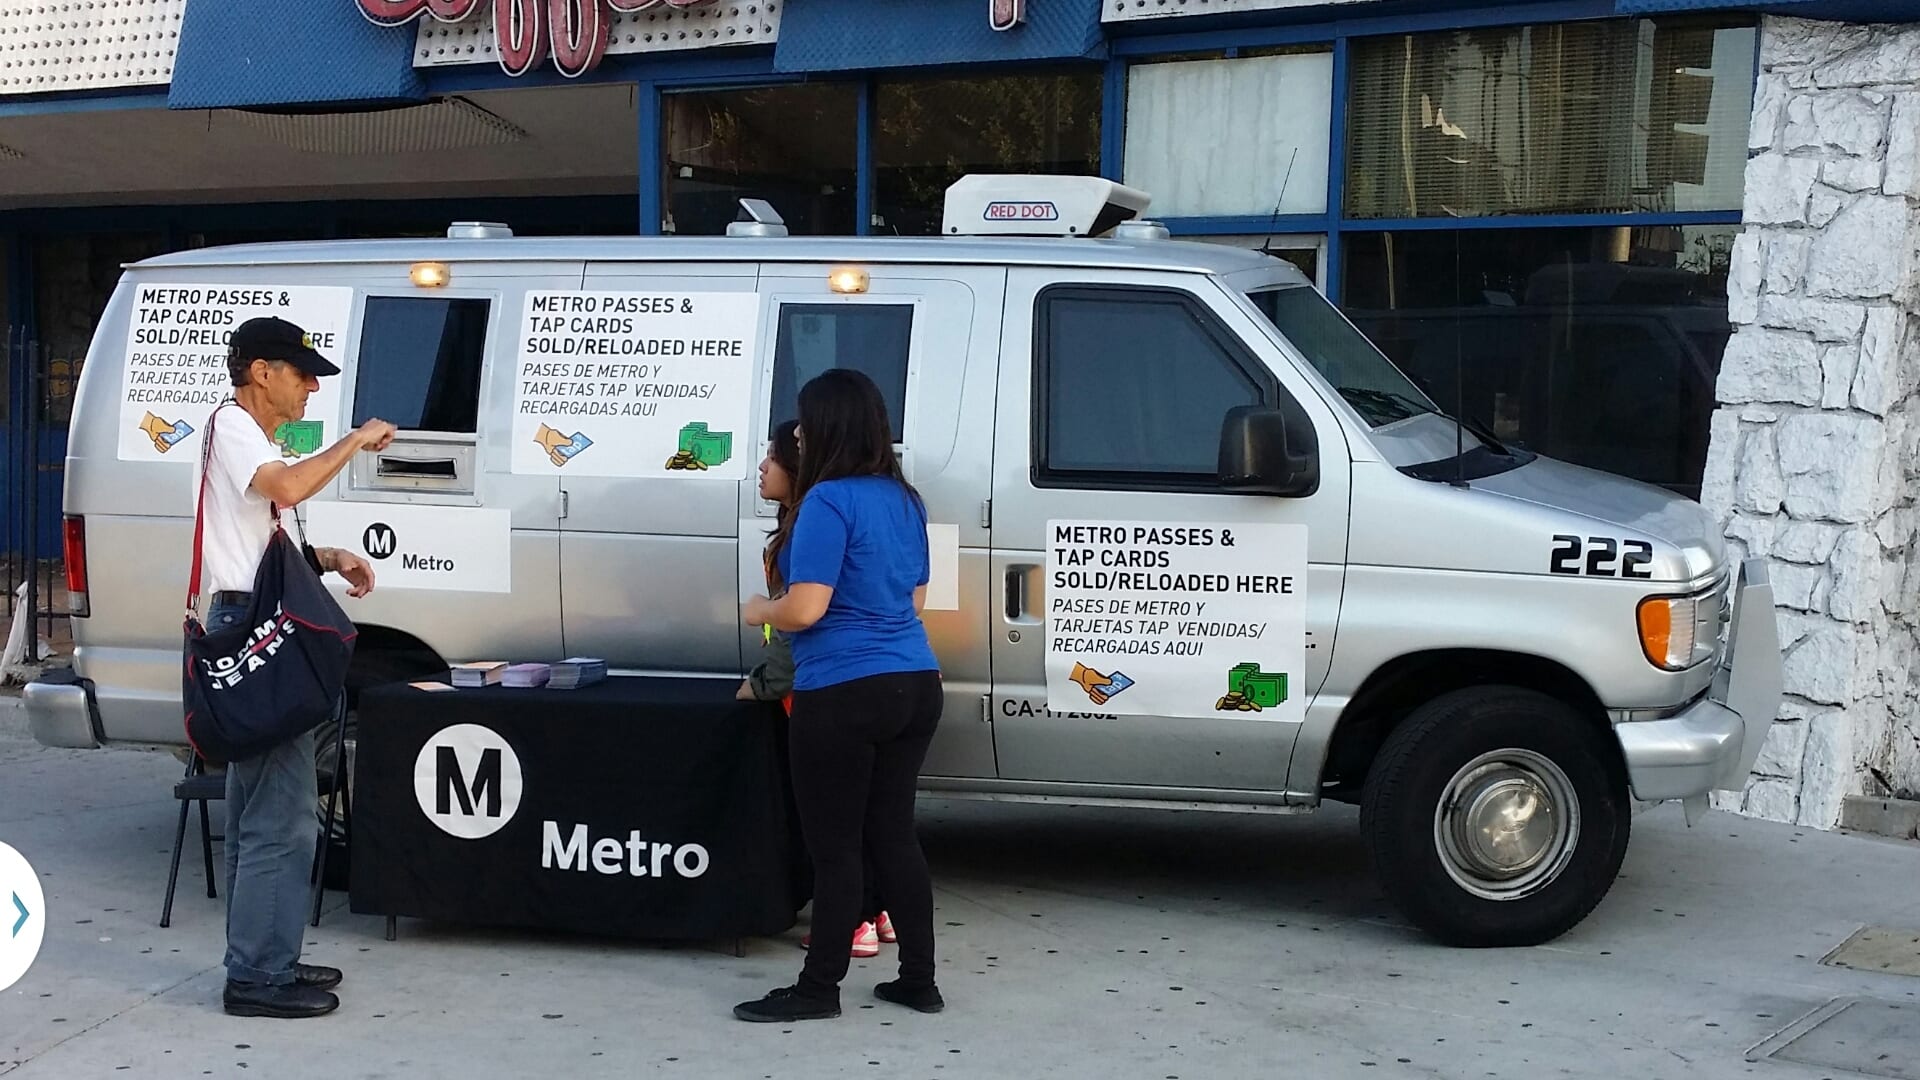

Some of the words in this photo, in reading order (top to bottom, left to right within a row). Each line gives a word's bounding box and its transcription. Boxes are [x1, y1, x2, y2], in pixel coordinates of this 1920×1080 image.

[990, 205, 1017, 218] RED
[1021, 205, 1052, 218] DOT
[141, 289, 201, 305] METRO
[205, 290, 273, 306] PASSES
[278, 291, 291, 307] &
[531, 296, 597, 313] METRO
[602, 297, 675, 314] PASSES
[680, 298, 694, 314] &
[139, 308, 172, 325] TAP
[176, 309, 234, 325] CARDS
[530, 317, 566, 333] TAP
[570, 317, 633, 334] CARDS
[134, 328, 232, 346] SOLD/RELO
[305, 332, 335, 349] RE
[526, 337, 685, 356] SOLD/RELOADED
[690, 340, 743, 357] HERE
[130, 352, 174, 367] PASES
[177, 353, 197, 368] DE
[198, 354, 229, 369] MET
[130, 370, 197, 386] TARJETAS
[201, 372, 227, 386] TAP
[522, 363, 570, 378] PASES
[573, 364, 595, 378] DE
[596, 364, 648, 379] METRO
[652, 365, 662, 379] Y
[127, 389, 218, 405] RECARGADAS
[522, 381, 595, 397] TARJETAS
[600, 383, 627, 397] TAP
[635, 383, 717, 400] VENDIDAS/
[520, 400, 618, 416] RECARGADAS
[620, 402, 657, 417] AQUI
[368, 528, 391, 554] M
[1055, 526, 1127, 545] METRO
[1133, 527, 1214, 546] PASSES
[1220, 529, 1235, 547] &
[402, 553, 454, 572] Metro
[1054, 548, 1095, 566] TAP
[1100, 550, 1170, 568] CARDS
[1550, 534, 1653, 579] 222
[1053, 571, 1230, 593] SOLD/RELOADED
[1236, 575, 1294, 594] HERE
[1052, 598, 1104, 614] PASES
[1108, 599, 1131, 615] DE
[1134, 600, 1191, 616] METRO
[1195, 602, 1206, 617] Y
[201, 599, 283, 671] TOMMY
[1053, 618, 1133, 635] TARJETAS
[1138, 620, 1169, 636] TAP
[1177, 621, 1267, 640] VENDIDAS/
[211, 618, 296, 690] JEANS
[1052, 638, 1160, 656] RECARGADAS
[1163, 641, 1204, 657] AQUI
[435, 745, 502, 818] M
[541, 820, 710, 878] Metro
